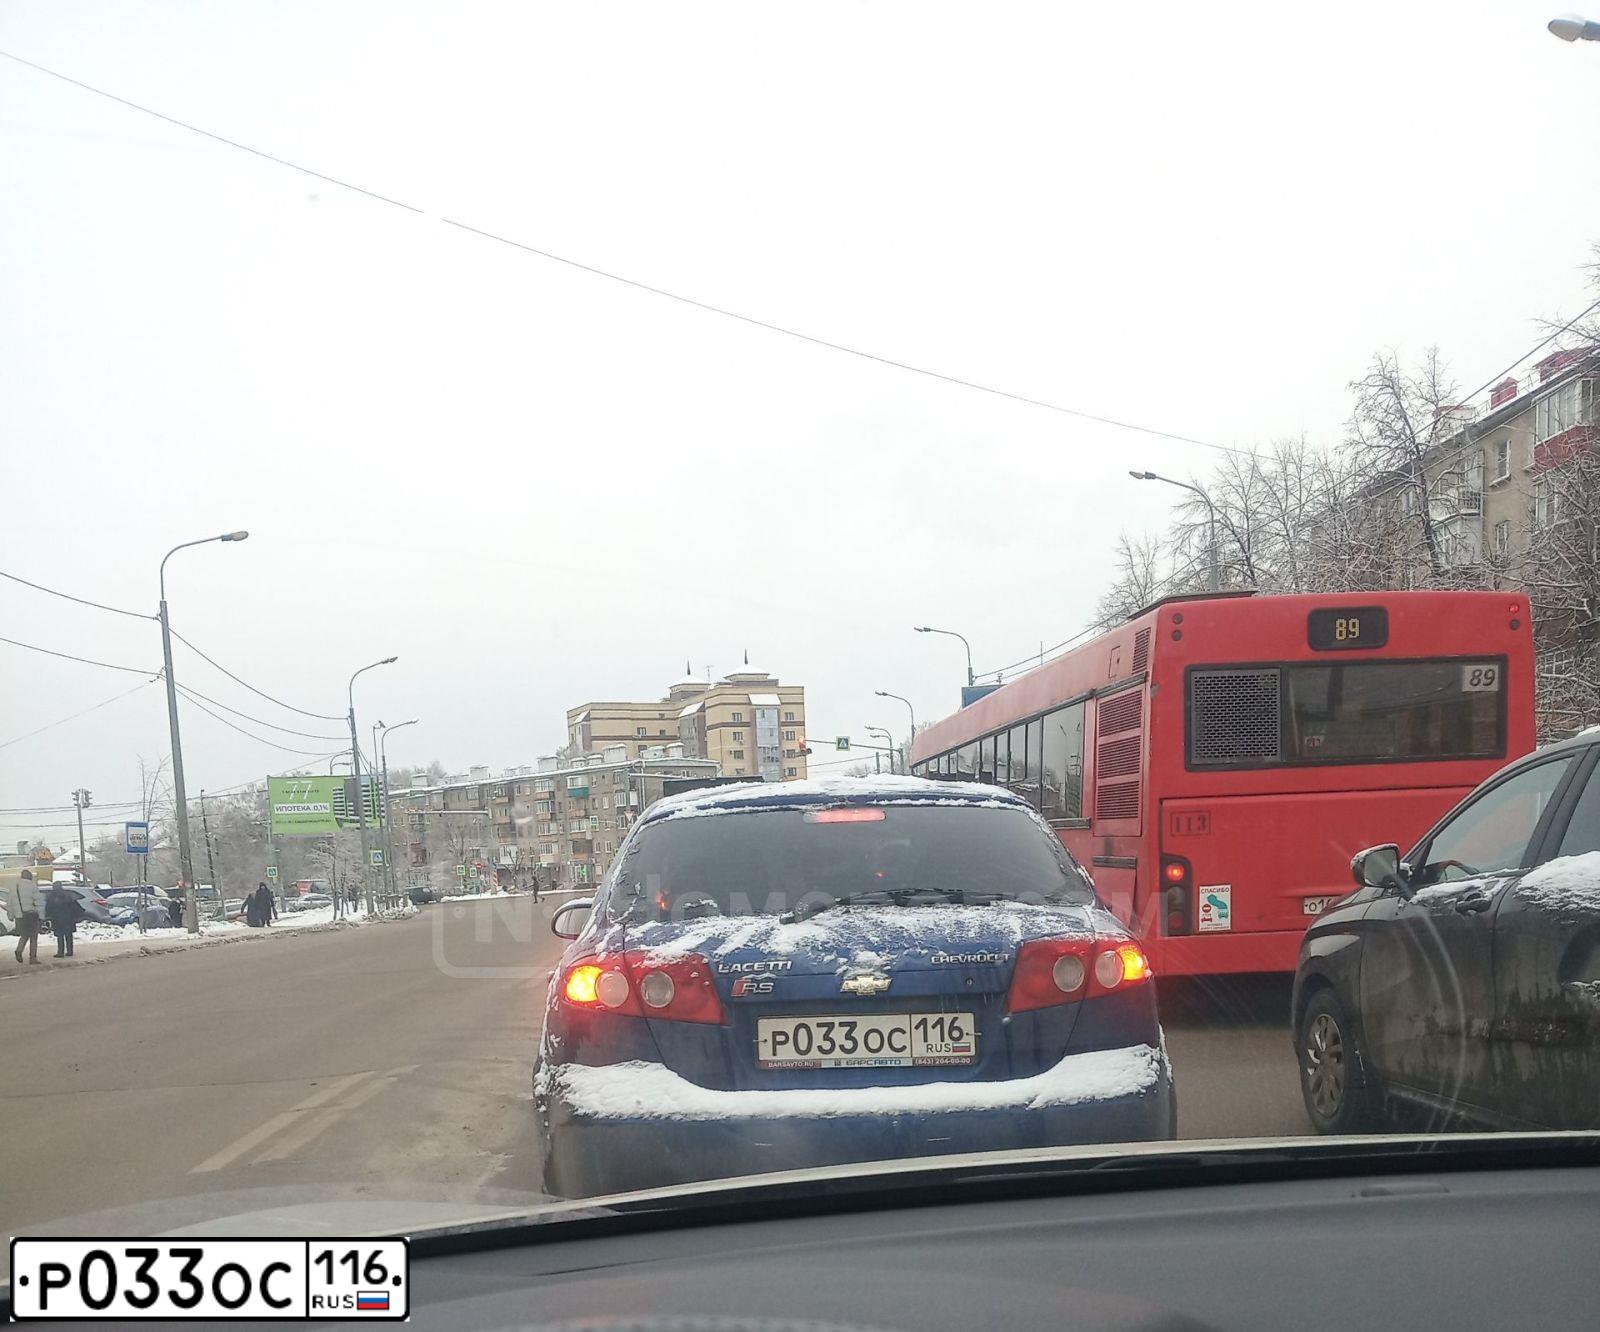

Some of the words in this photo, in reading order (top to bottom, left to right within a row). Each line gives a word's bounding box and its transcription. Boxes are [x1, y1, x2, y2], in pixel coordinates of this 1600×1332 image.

[1335, 618, 1360, 640] 89
[1469, 669, 1496, 687] 89
[1175, 815, 1207, 833] 113
[1200, 886, 1230, 894] СПАСИБО
[718, 960, 793, 973] LACETTI
[741, 982, 774, 994] RS
[914, 1016, 964, 1042] 116
[926, 1043, 952, 1053] RUS
